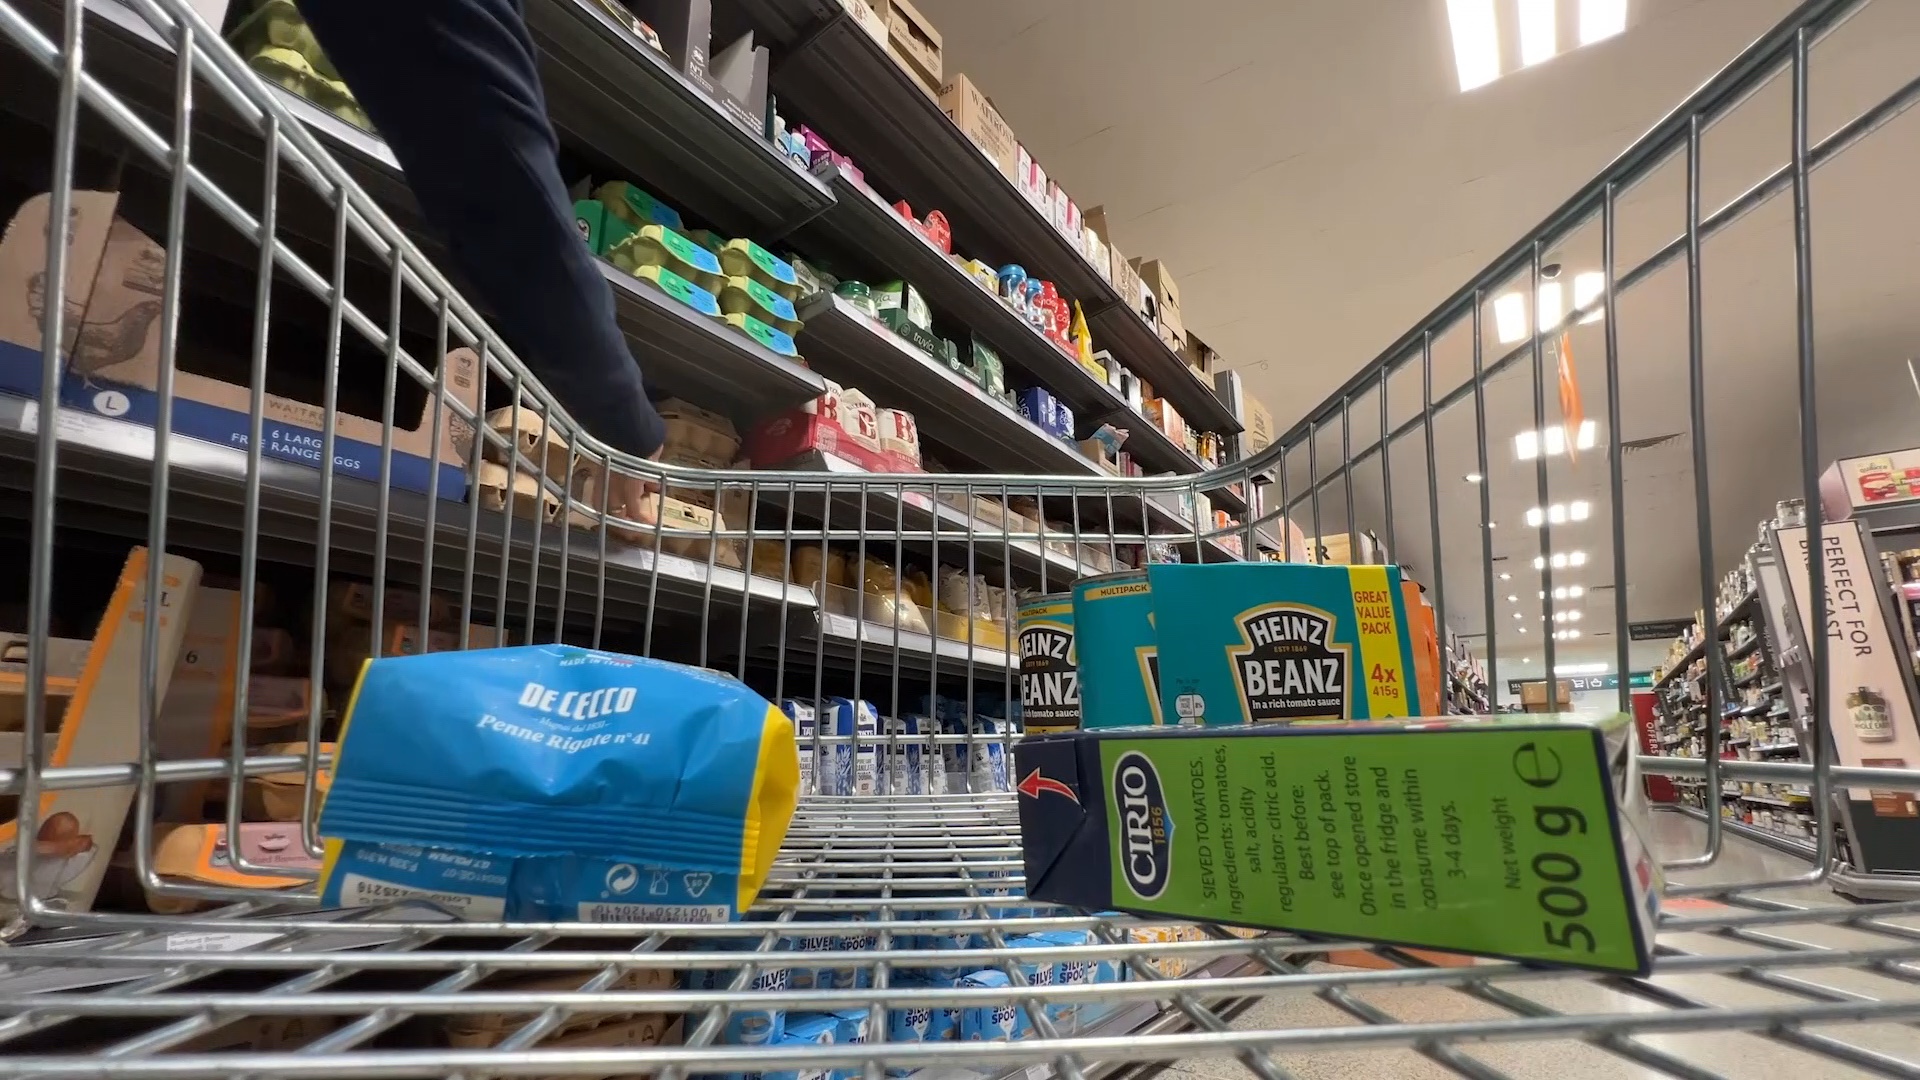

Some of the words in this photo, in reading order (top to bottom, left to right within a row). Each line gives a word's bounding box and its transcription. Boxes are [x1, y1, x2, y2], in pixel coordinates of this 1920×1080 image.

[105, 395, 118, 411] L
[231, 432, 266, 449] FRE
[271, 442, 322, 461] RANGE
[333, 456, 362, 470] GGS
[271, 429, 280, 439] 6
[284, 432, 323, 449] LARG
[1099, 584, 1148, 597] MULTIPACK
[1353, 591, 1388, 604] GREAT
[1822, 536, 1861, 613] PERFECT
[1845, 619, 1873, 657] FOR
[1356, 606, 1391, 619] VALUE
[1361, 622, 1392, 635] PACK
[1250, 616, 1324, 647] HEINZ
[186, 650, 198, 664] 6
[1371, 663, 1397, 683] 4x
[1244, 658, 1342, 697] BEANZ
[1372, 686, 1399, 698] 415g
[518, 682, 559, 713] DE
[557, 687, 638, 721] CECCO
[1055, 709, 1080, 718] sauce
[1252, 700, 1261, 709] In
[1262, 701, 1268, 709] a
[1269, 698, 1286, 709] rich
[1286, 698, 1317, 708] tomato
[1317, 698, 1341, 706] sauce
[476, 713, 545, 743] Penne
[546, 732, 611, 754] Rigate
[802, 727, 815, 736] TAT
[1646, 721, 1660, 754] OFFERS
[1215, 744, 1231, 819] tomatoes,
[1260, 751, 1277, 788] acid.
[1343, 755, 1361, 797] store
[1368, 766, 1390, 799] and
[1190, 756, 1210, 843] TOMATOES.
[1314, 768, 1337, 813] pack.
[1401, 768, 1425, 824] within
[1122, 766, 1157, 885] CIRIO
[1151, 806, 1166, 844] 1856
[1239, 786, 1257, 839] acidity
[1264, 791, 1282, 831] citric
[1291, 785, 1310, 841] before:
[1318, 816, 1336, 834] of
[1377, 802, 1399, 854] fridge
[1441, 800, 1463, 846] days.
[1491, 796, 1517, 855] weight
[1533, 804, 1587, 837] g
[1326, 837, 1343, 866] top
[1345, 801, 1372, 868] opened
[1199, 845, 1218, 900] SIEVED
[1219, 823, 1245, 915] Ingredients:
[1245, 842, 1262, 874] salt,
[1271, 834, 1294, 913] regulator:
[1298, 845, 1316, 881] Best
[1384, 858, 1404, 887] the
[1413, 827, 1439, 910] consume
[1444, 850, 1467, 880] 3-4
[1504, 859, 1521, 890] Net
[1330, 871, 1346, 899] see
[1359, 871, 1378, 917] Once
[1390, 891, 1406, 909] in
[717, 907, 725, 918] 8
[1531, 852, 1596, 954] 500
[905, 1010, 929, 1027] SPOO
[991, 1009, 1015, 1024] SPOO
